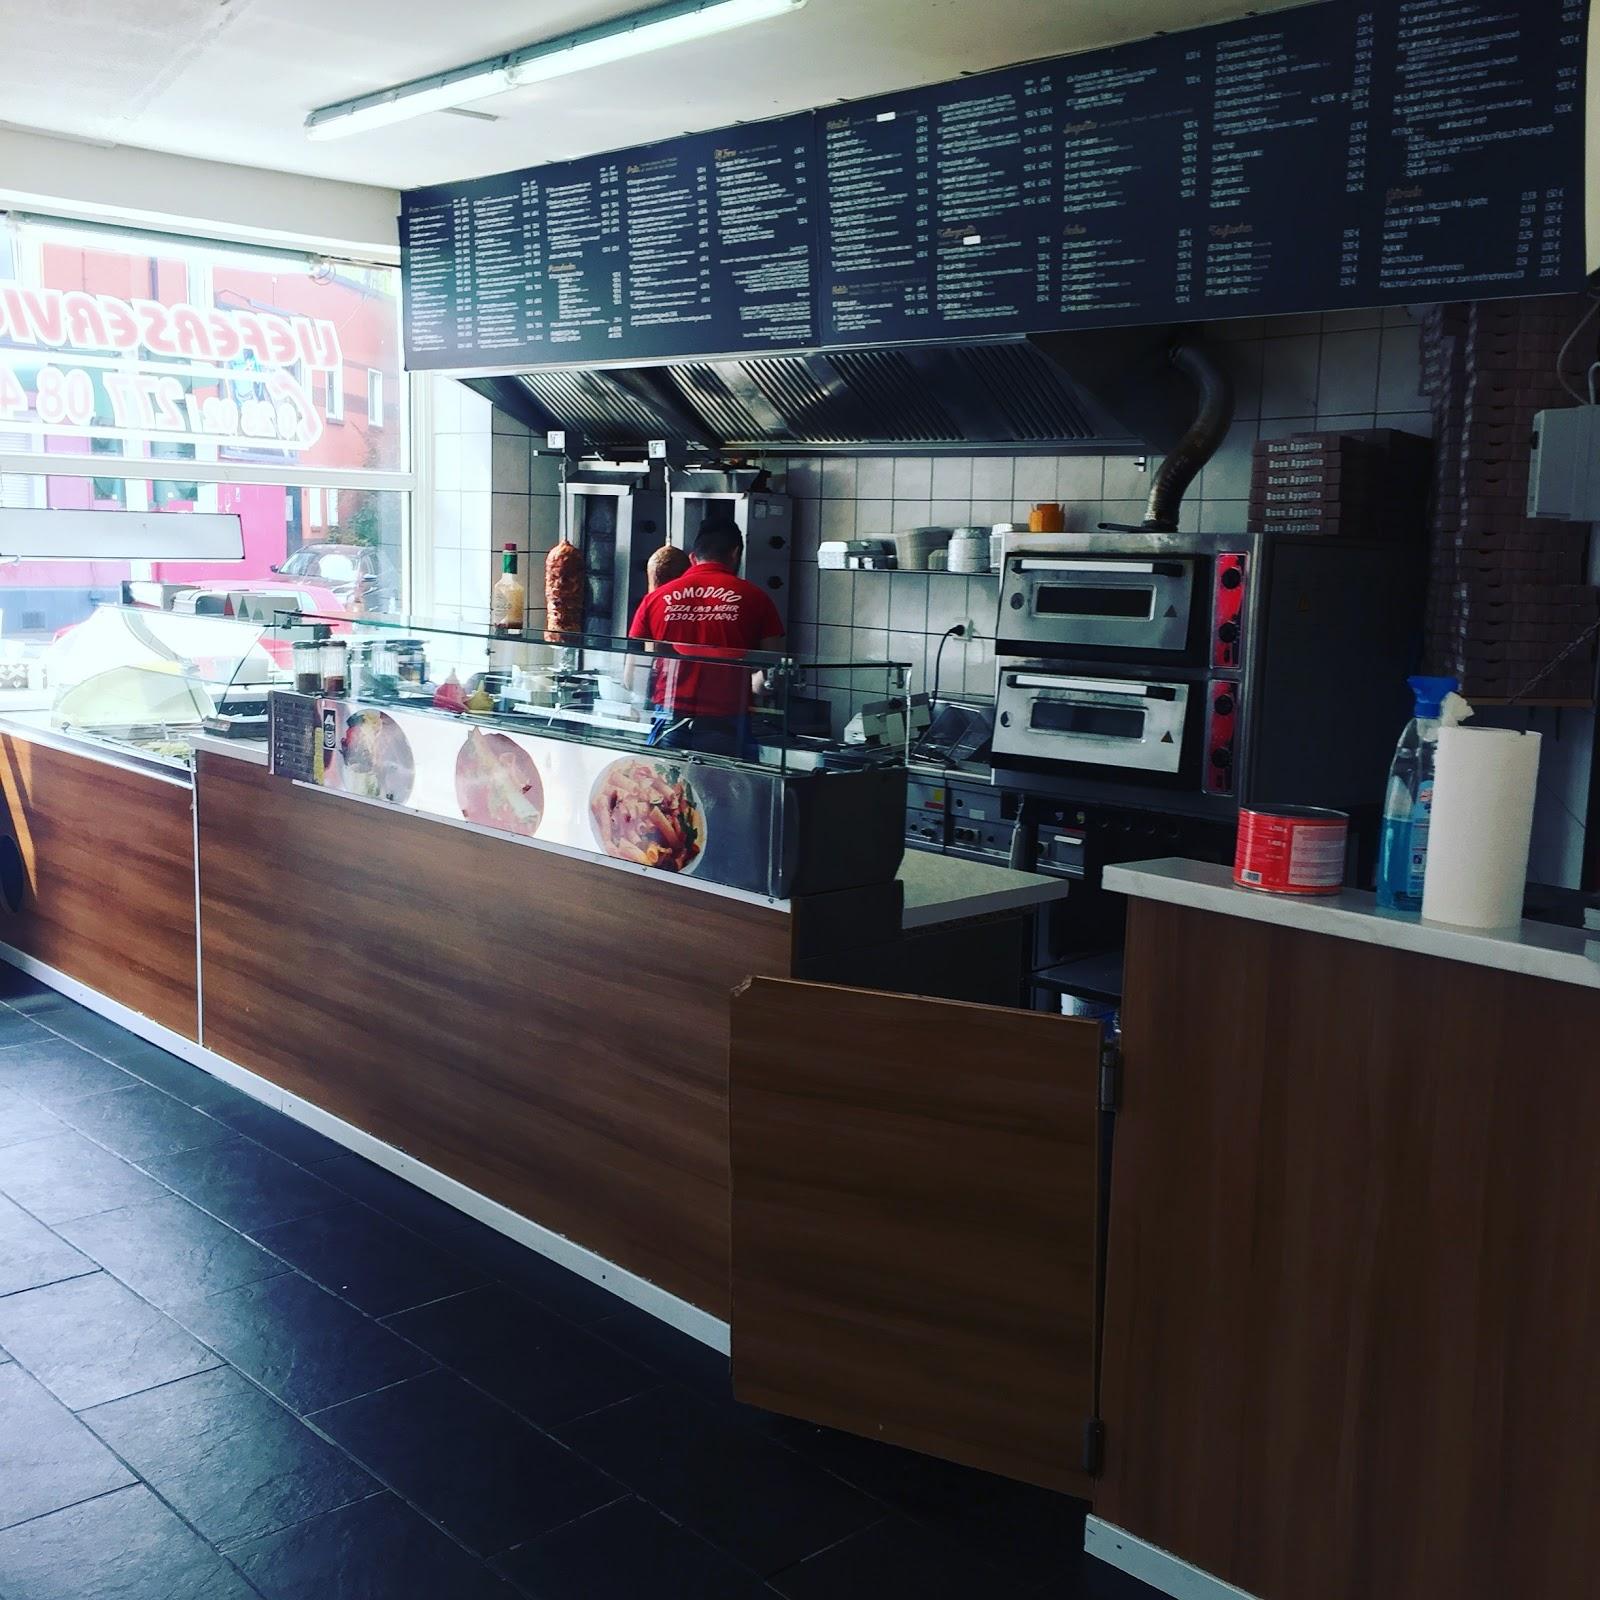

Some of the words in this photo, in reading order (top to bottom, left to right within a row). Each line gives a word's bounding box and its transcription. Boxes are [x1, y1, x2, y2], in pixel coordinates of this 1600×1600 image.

[663, 586, 742, 605] POMODORO
[664, 605, 691, 613] PIZZA
[712, 604, 739, 612] MEHR
